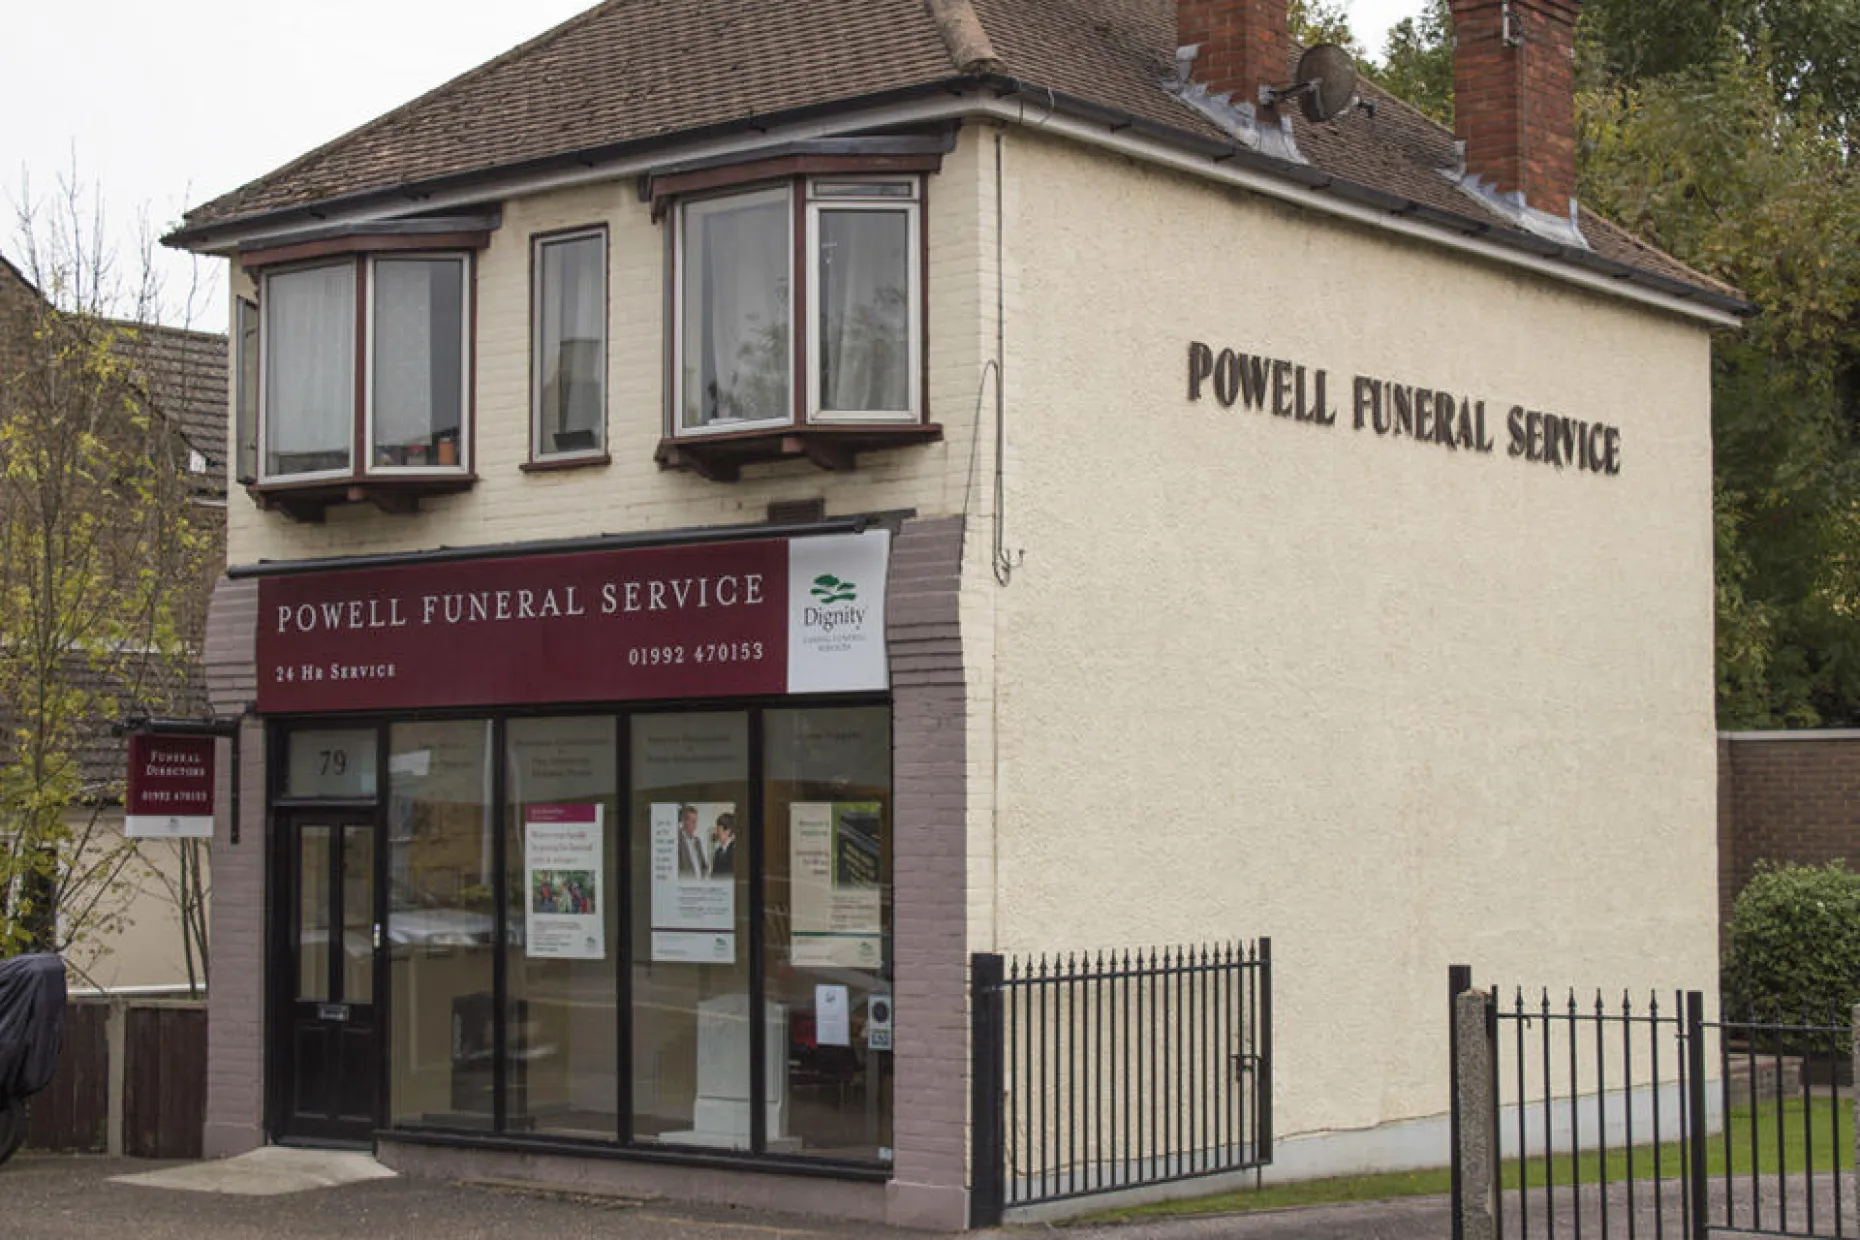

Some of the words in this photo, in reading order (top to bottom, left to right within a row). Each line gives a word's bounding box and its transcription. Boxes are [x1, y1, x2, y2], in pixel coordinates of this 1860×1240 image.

[1187, 341, 1335, 426] POWELL
[1353, 374, 1493, 453] FUNERAL
[1507, 404, 1621, 475] SERVICE
[276, 597, 407, 633] POWELL
[421, 586, 584, 624] FUNERAL
[601, 573, 764, 614] SERVICE
[804, 605, 865, 633] Dignity
[628, 645, 685, 667] 01992
[693, 641, 763, 663] 470153
[276, 665, 295, 683] 24
[318, 750, 347, 776] 79
